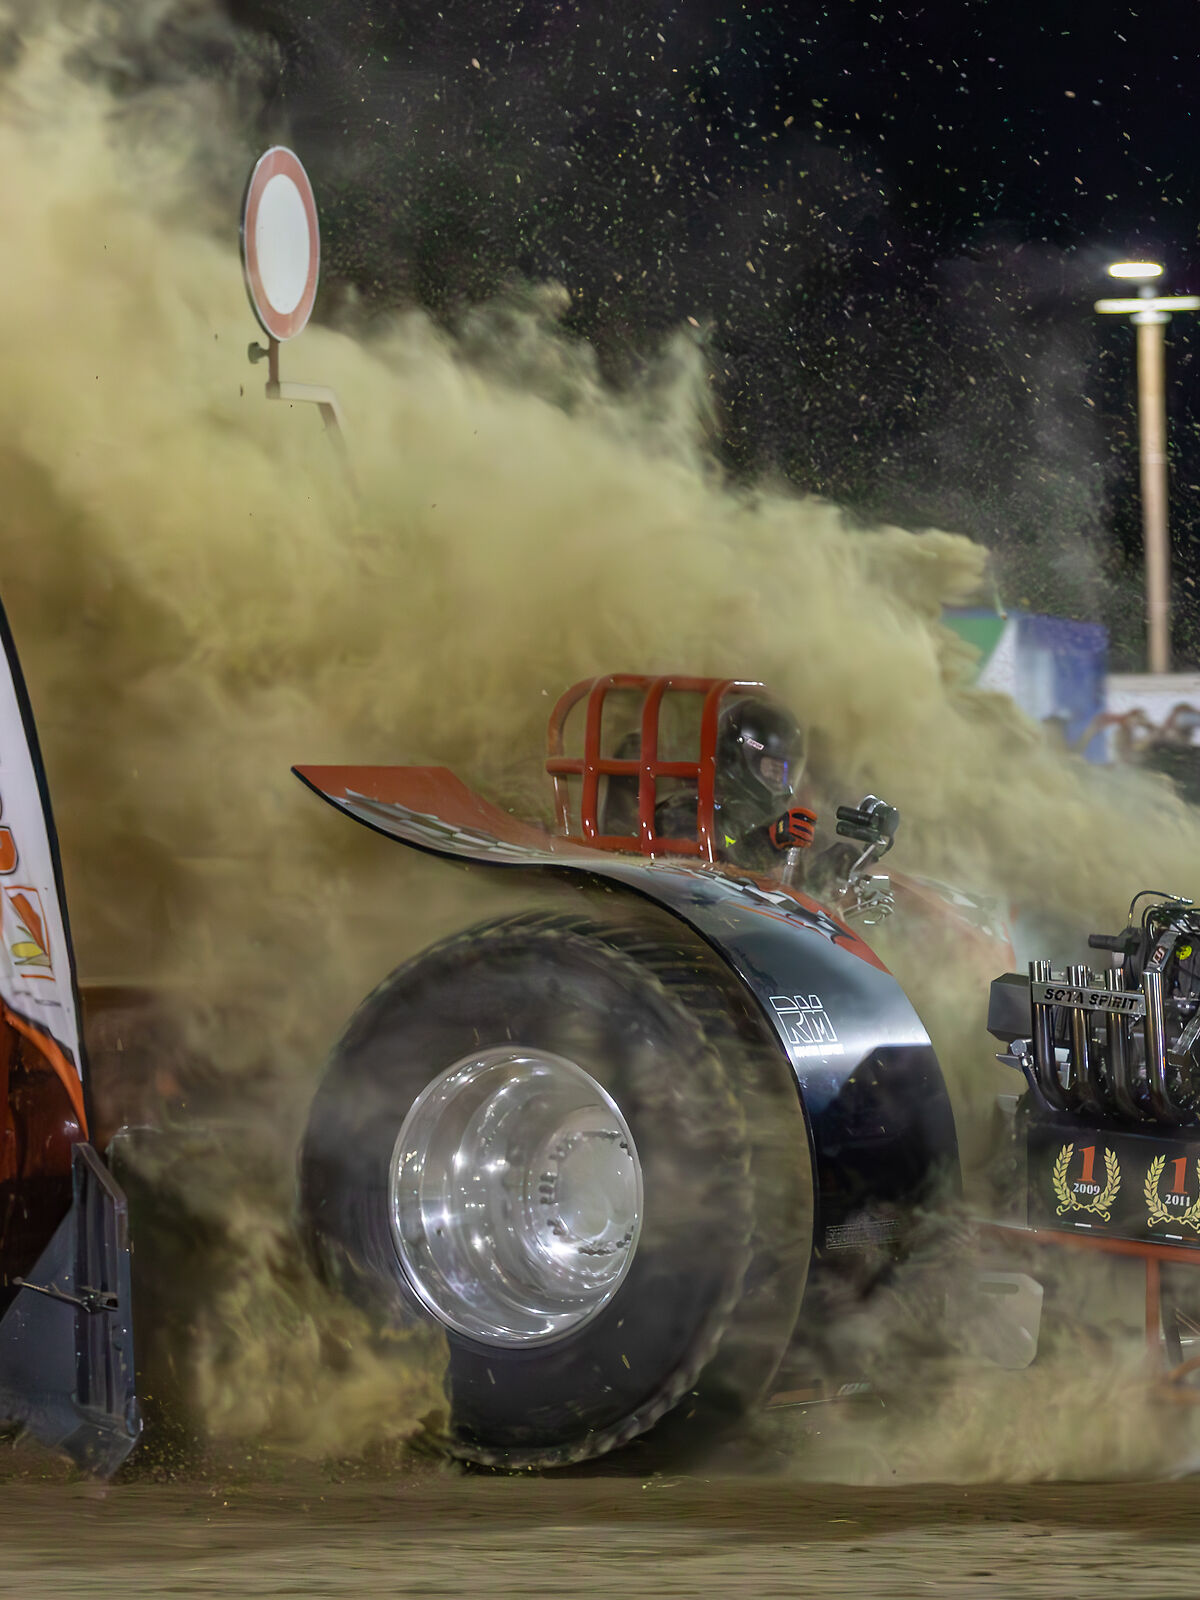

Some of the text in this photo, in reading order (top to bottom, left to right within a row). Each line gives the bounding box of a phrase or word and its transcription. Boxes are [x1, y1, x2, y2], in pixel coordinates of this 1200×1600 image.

[1089, 993, 1139, 1010] SPIRIT
[1076, 1145, 1097, 1183] 1
[1170, 1156, 1189, 1195] 1
[1073, 1182, 1101, 1196] 2009
[1165, 1194, 1191, 1207] 2011
